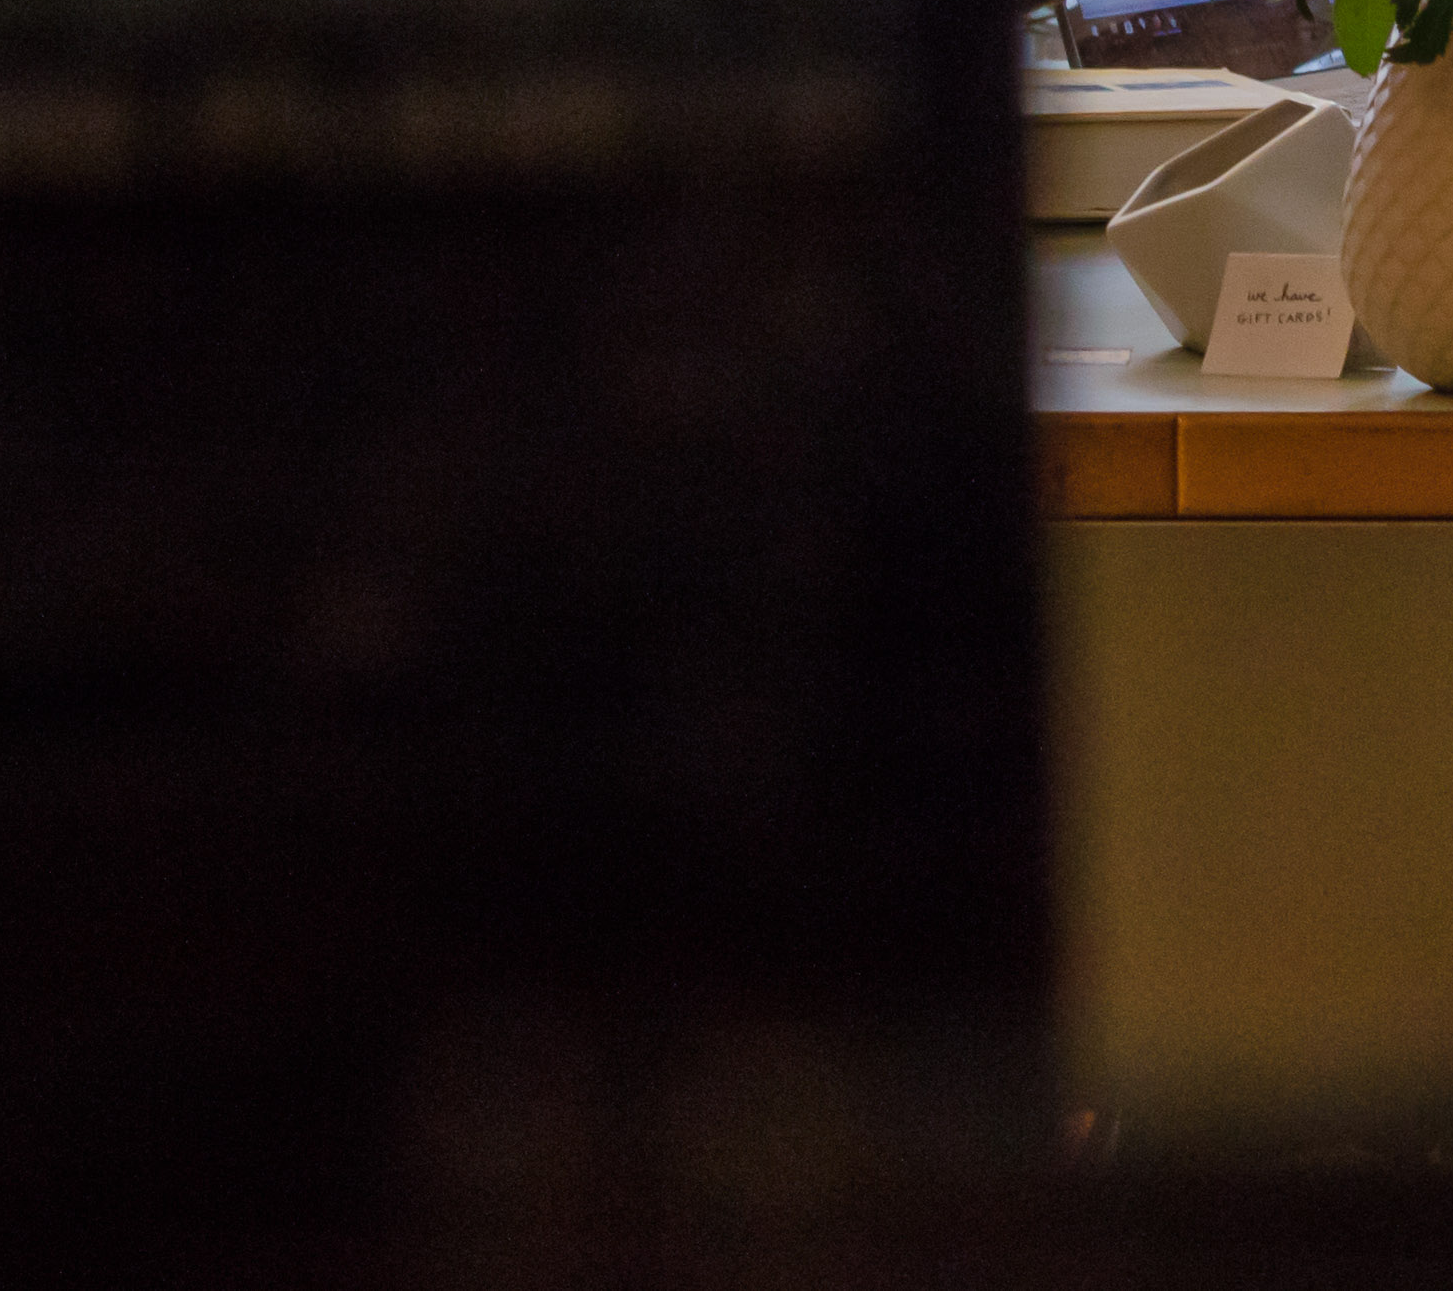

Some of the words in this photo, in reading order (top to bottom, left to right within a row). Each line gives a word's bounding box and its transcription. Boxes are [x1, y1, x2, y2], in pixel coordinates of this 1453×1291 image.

[1247, 291, 1268, 303] we
[1274, 282, 1323, 303] have
[1237, 313, 1272, 325] GIFT
